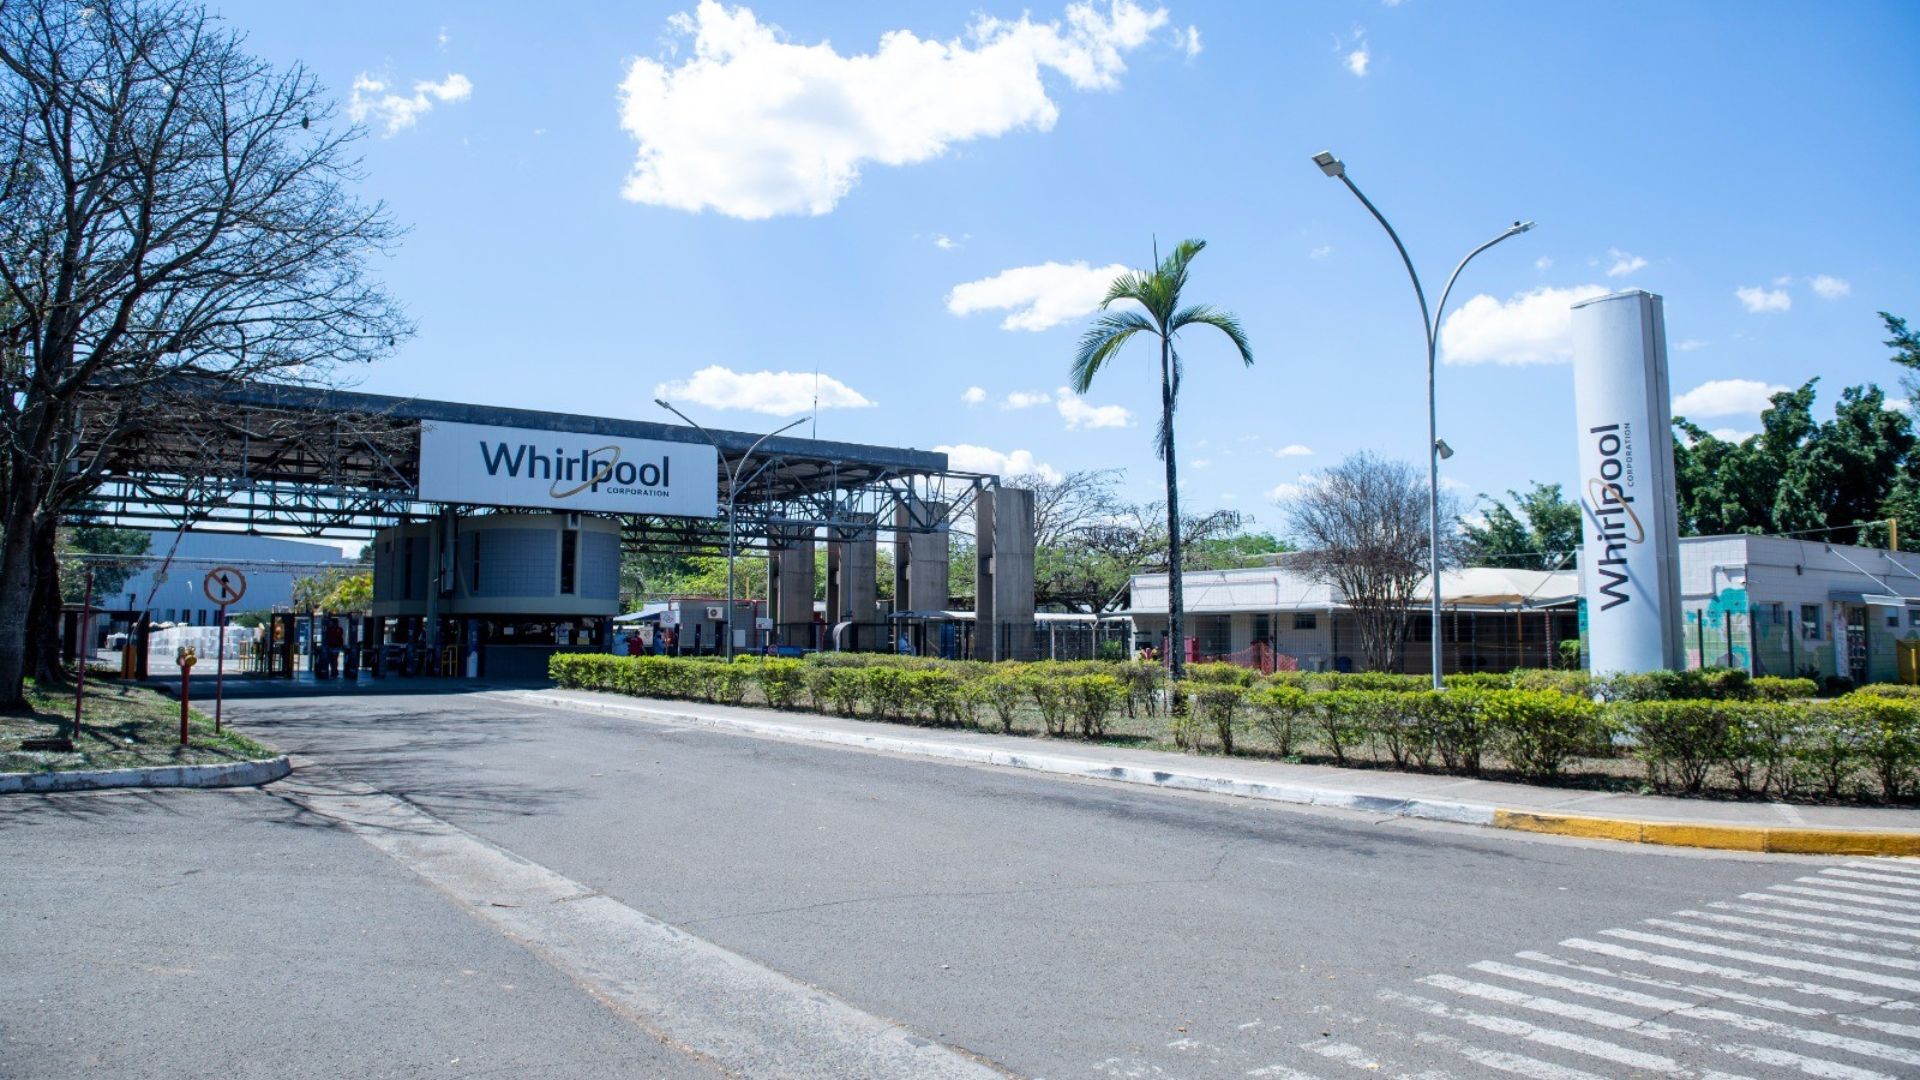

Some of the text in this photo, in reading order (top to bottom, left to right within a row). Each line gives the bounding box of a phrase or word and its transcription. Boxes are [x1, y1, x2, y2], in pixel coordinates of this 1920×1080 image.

[480, 441, 669, 492] Whirlpool
[1624, 422, 1634, 487] CORPORATION
[606, 487, 669, 497] CORPORATION
[1590, 424, 1634, 611] Whirlpool
